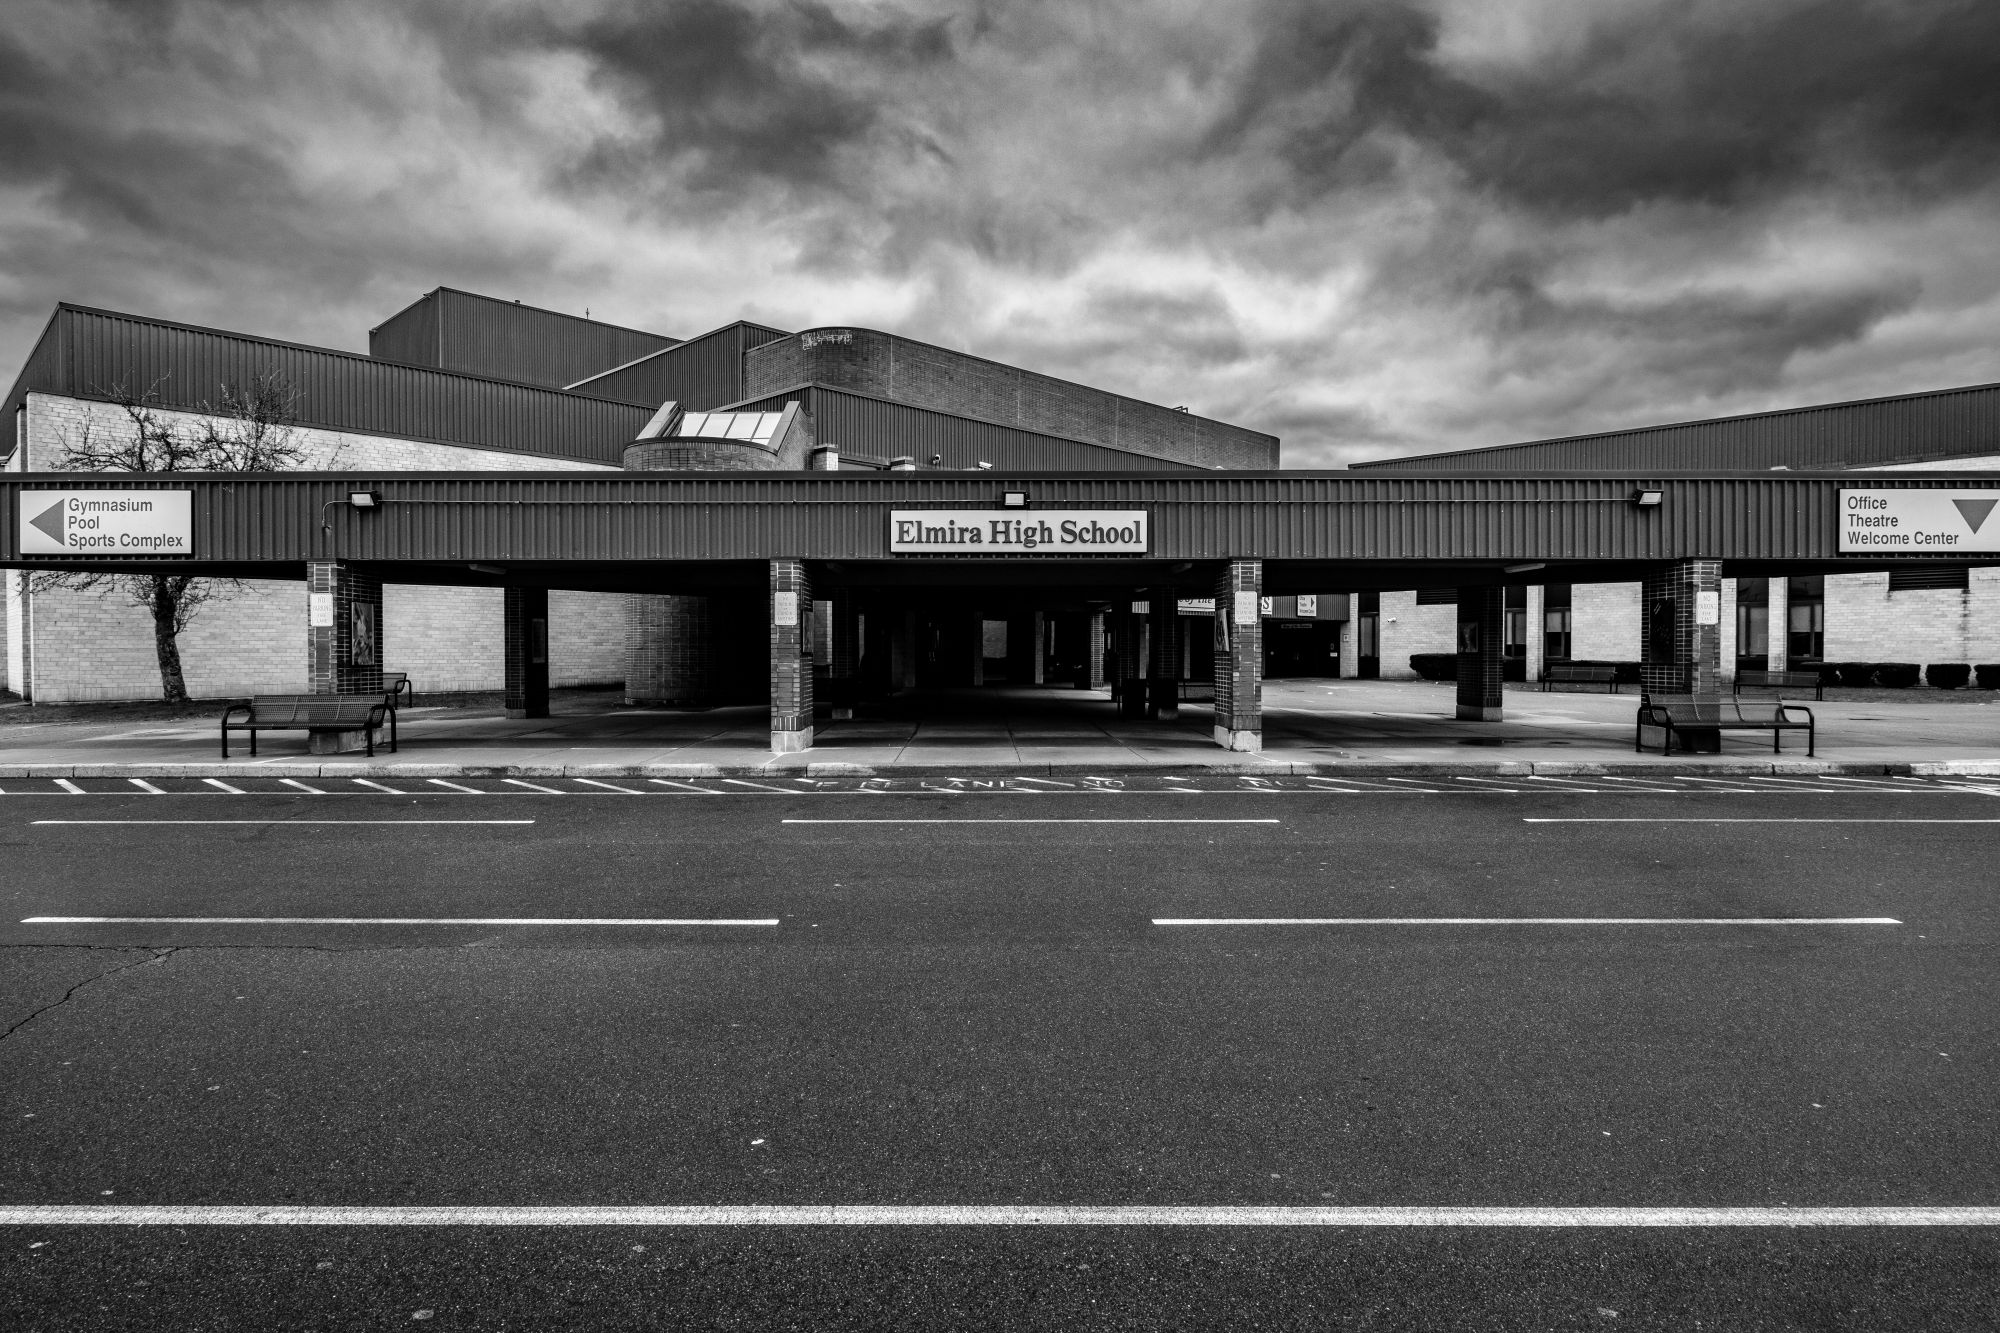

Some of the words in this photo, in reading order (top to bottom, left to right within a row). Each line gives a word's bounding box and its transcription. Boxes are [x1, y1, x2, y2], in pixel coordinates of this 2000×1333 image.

[68, 497, 153, 515] Gymnasium
[1847, 496, 1888, 510] Office
[68, 516, 100, 529] Pool
[1847, 514, 1899, 527] Theatre
[895, 519, 983, 544] Elmira
[988, 519, 1054, 548] High
[1060, 520, 1142, 544] School
[1847, 531, 1910, 545] Welcome
[1914, 531, 1960, 545] Center
[68, 533, 116, 550] Sports
[120, 533, 183, 550] Complex
